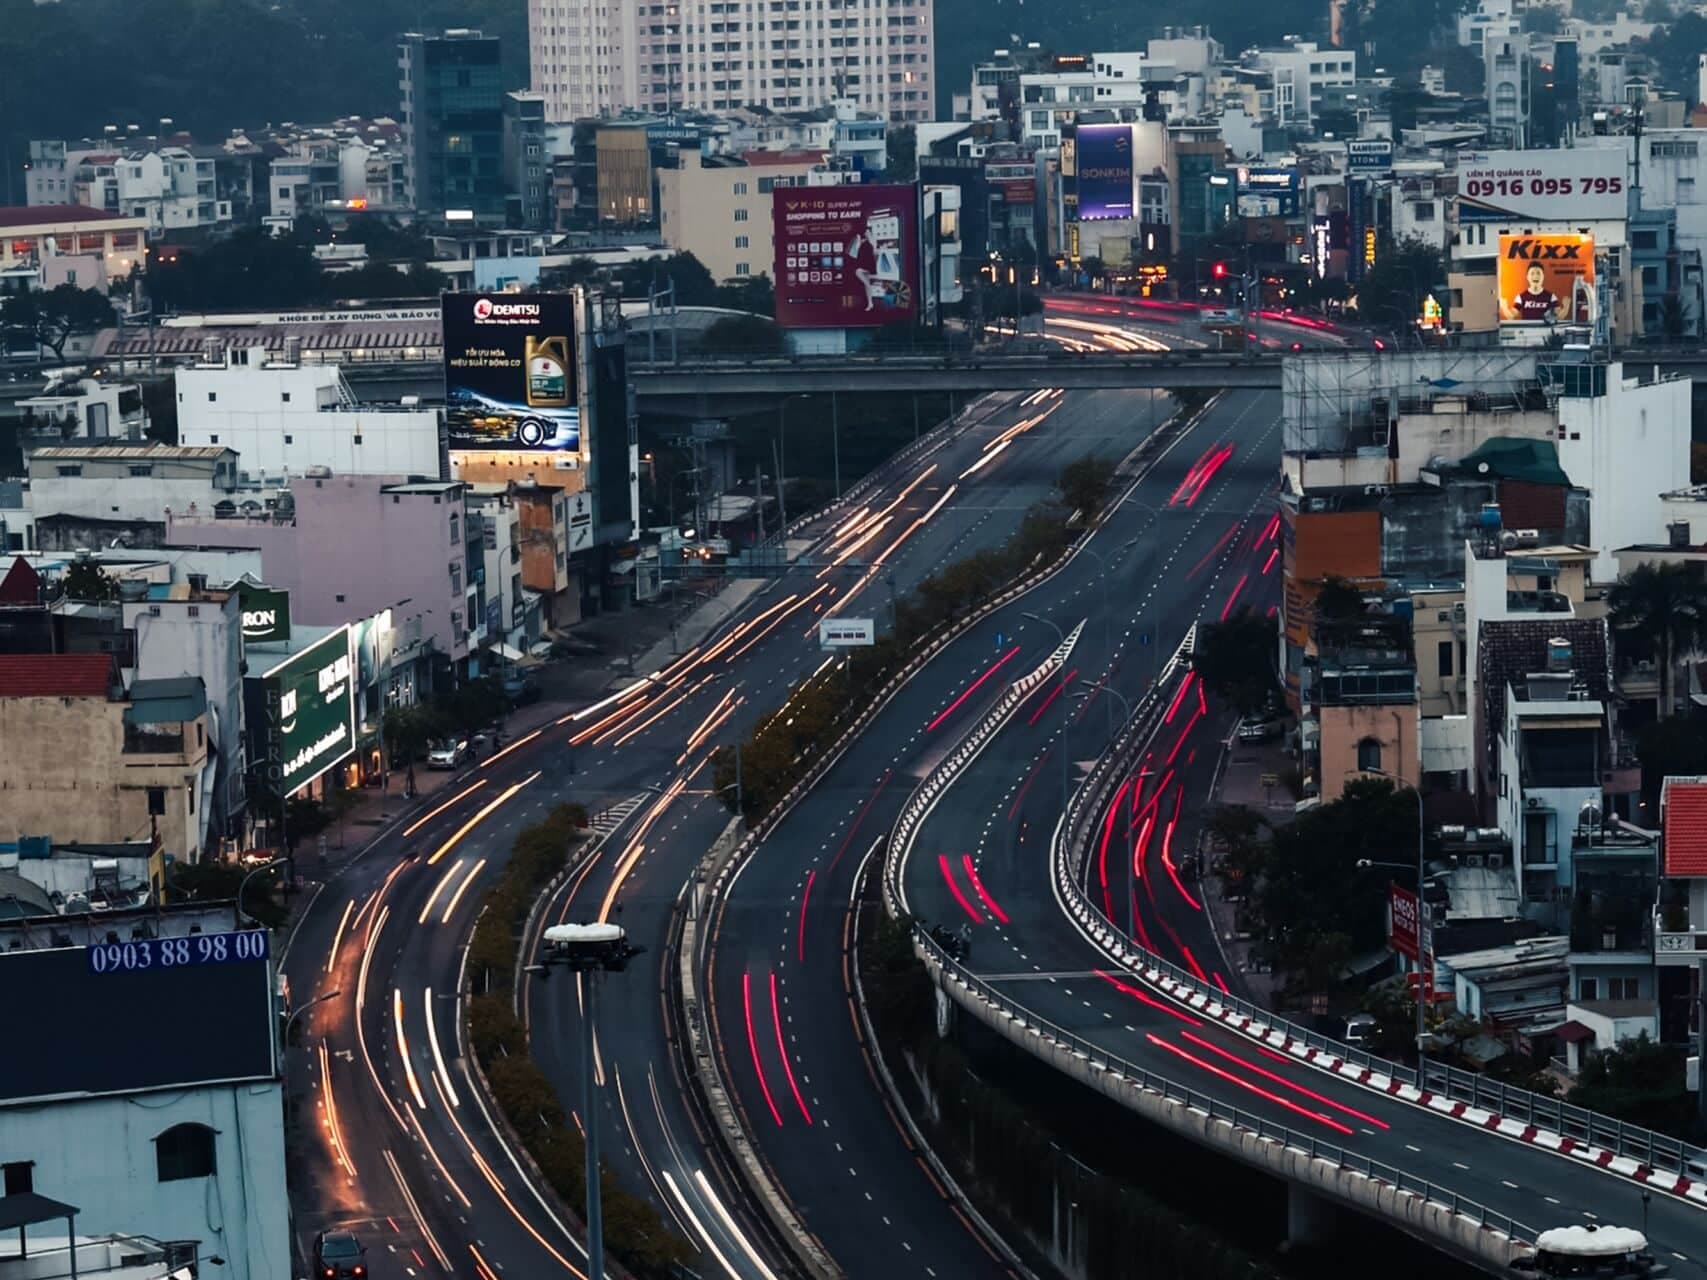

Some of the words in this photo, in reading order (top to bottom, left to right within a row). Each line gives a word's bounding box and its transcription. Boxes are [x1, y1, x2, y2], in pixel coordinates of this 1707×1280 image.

[1467, 170, 1483, 178] LIÊN
[1526, 168, 1542, 176] CÁO
[1467, 179, 1524, 197] 0916
[1530, 178, 1573, 195] 095
[1579, 177, 1622, 194] 795
[786, 212, 825, 221] SHOPPING
[828, 211, 838, 219] TO
[840, 211, 862, 219] EARN
[1508, 239, 1582, 260] Kixx
[493, 304, 540, 315] IDEMITSU
[1524, 300, 1548, 309] Kixx
[92, 942, 151, 973] 0903
[161, 939, 190, 967] 88
[199, 936, 228, 963] 98
[236, 932, 265, 959] 00
